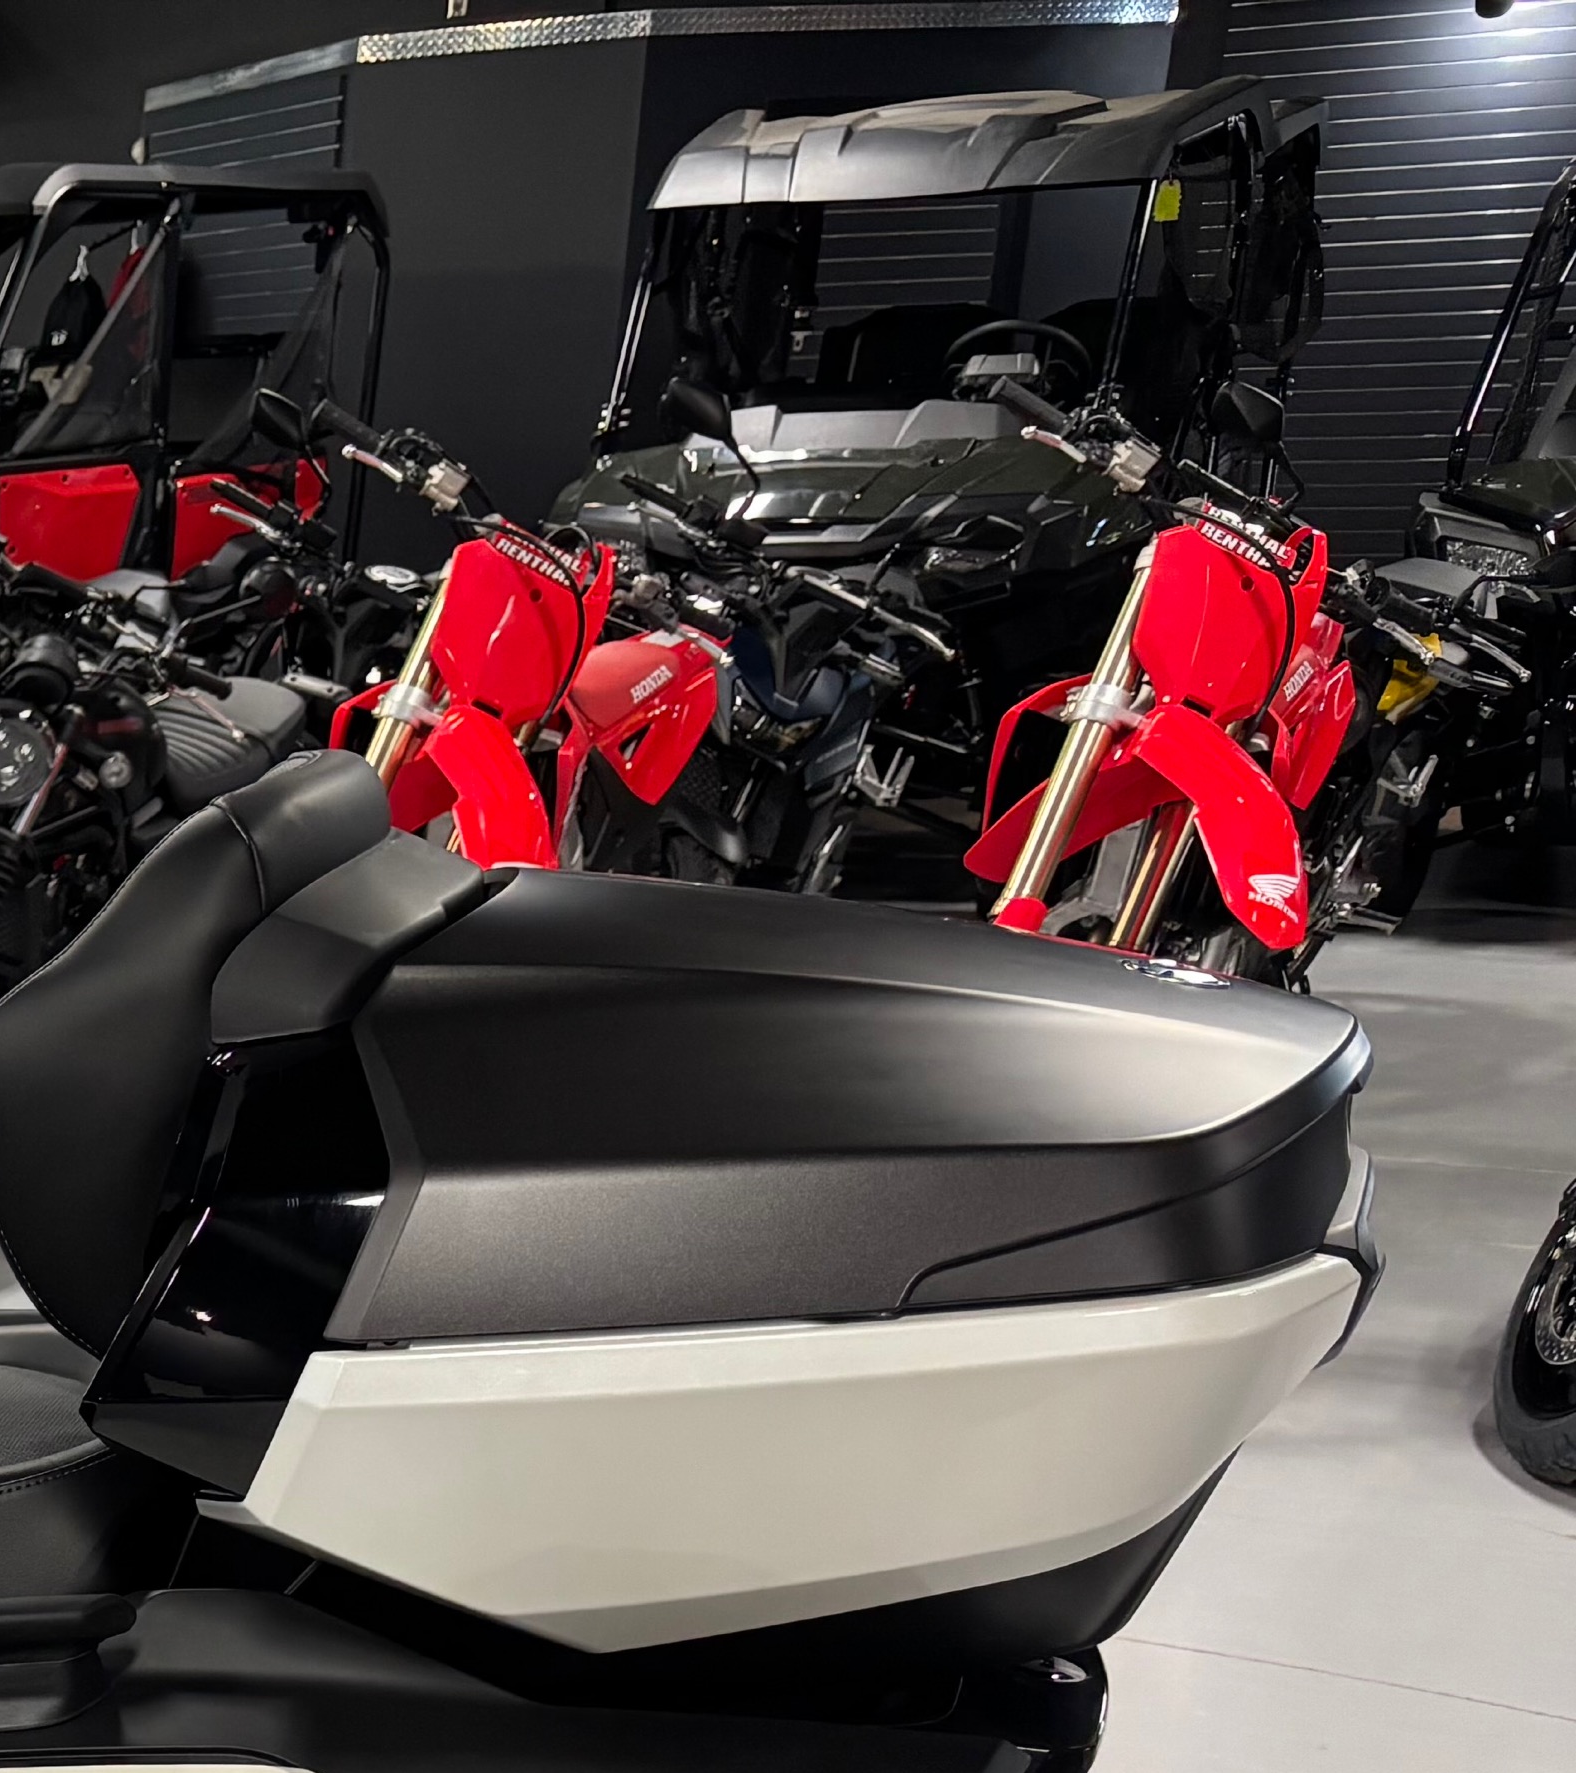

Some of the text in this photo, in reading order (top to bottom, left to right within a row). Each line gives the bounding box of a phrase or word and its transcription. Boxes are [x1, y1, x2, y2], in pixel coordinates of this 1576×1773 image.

[496, 539, 571, 586] RENTHA
[630, 665, 673, 704] HONDA
[1283, 661, 1314, 701] HONDA
[1248, 891, 1299, 924] HONDA
